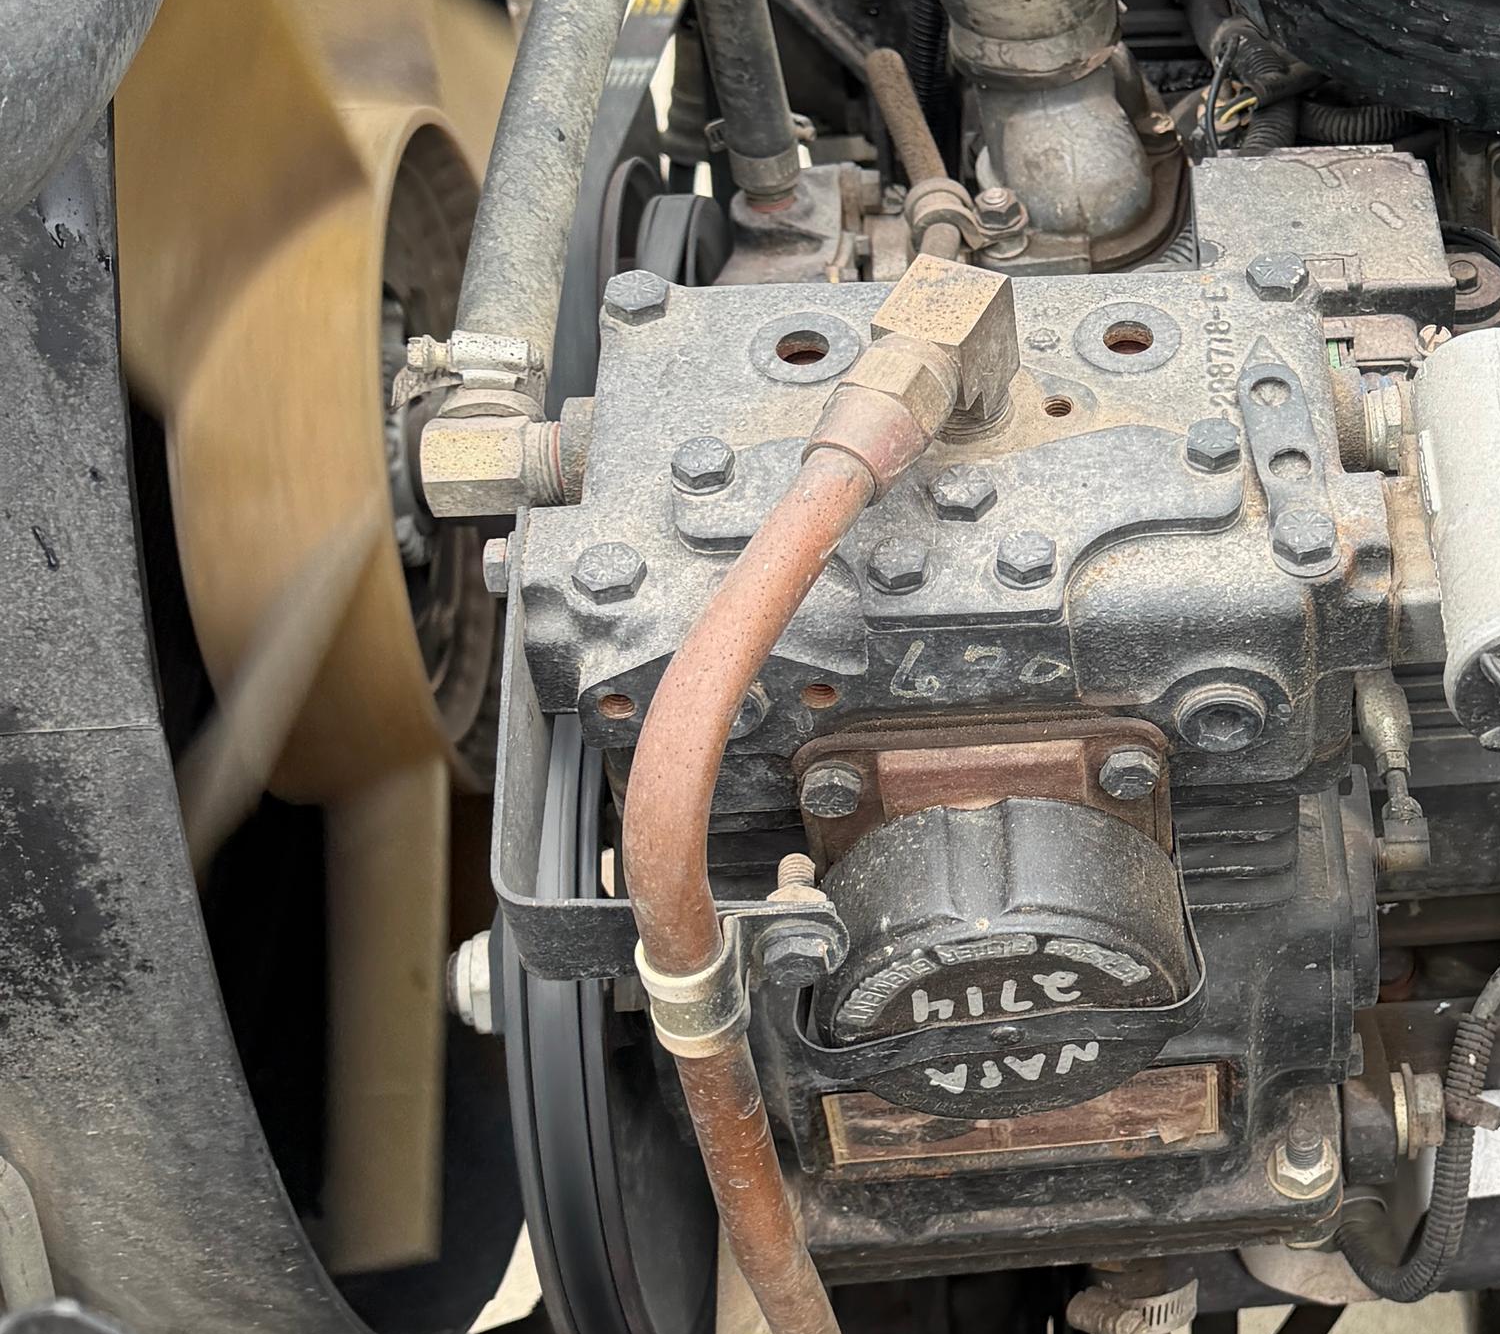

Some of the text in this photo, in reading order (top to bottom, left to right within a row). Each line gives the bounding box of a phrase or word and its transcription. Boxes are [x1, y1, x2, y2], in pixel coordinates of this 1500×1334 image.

[932, 934, 1038, 966] FILTER
[835, 948, 941, 1028] ELEMENT
[910, 970, 1083, 1024] 2714
[923, 1040, 1100, 1095] NAPA
